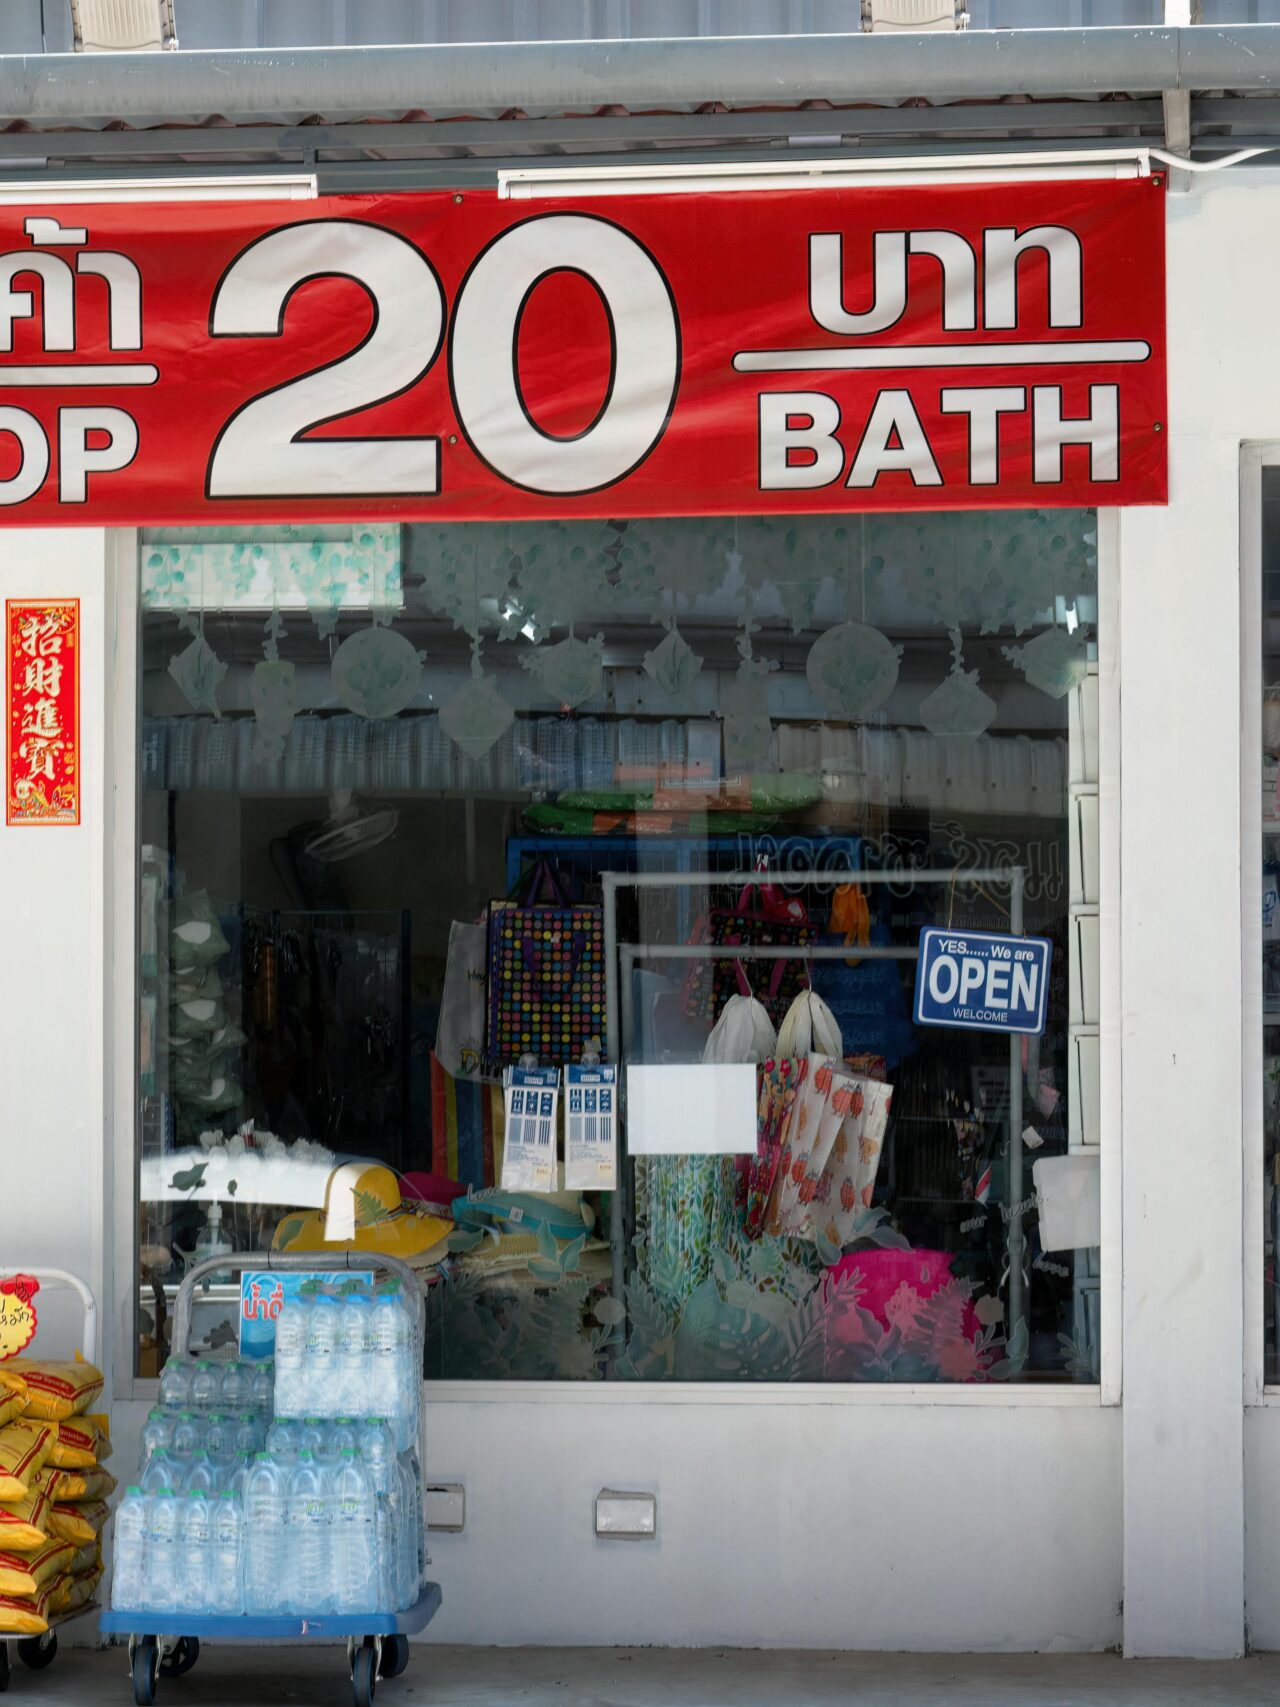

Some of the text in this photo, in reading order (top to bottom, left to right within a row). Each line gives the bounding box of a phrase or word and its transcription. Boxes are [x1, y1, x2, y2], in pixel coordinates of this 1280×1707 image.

[807, 224, 1083, 336] บาท
[205, 211, 682, 500] 20
[757, 384, 1120, 491] BATH
[19, 614, 64, 781] 招財進寶
[929, 954, 1039, 1012] OPEN
[991, 945, 1011, 959] We
[1014, 950, 1034, 961] are
[953, 1007, 1008, 1022] WELCOME
[243, 1282, 284, 1320] น้ำดื่
